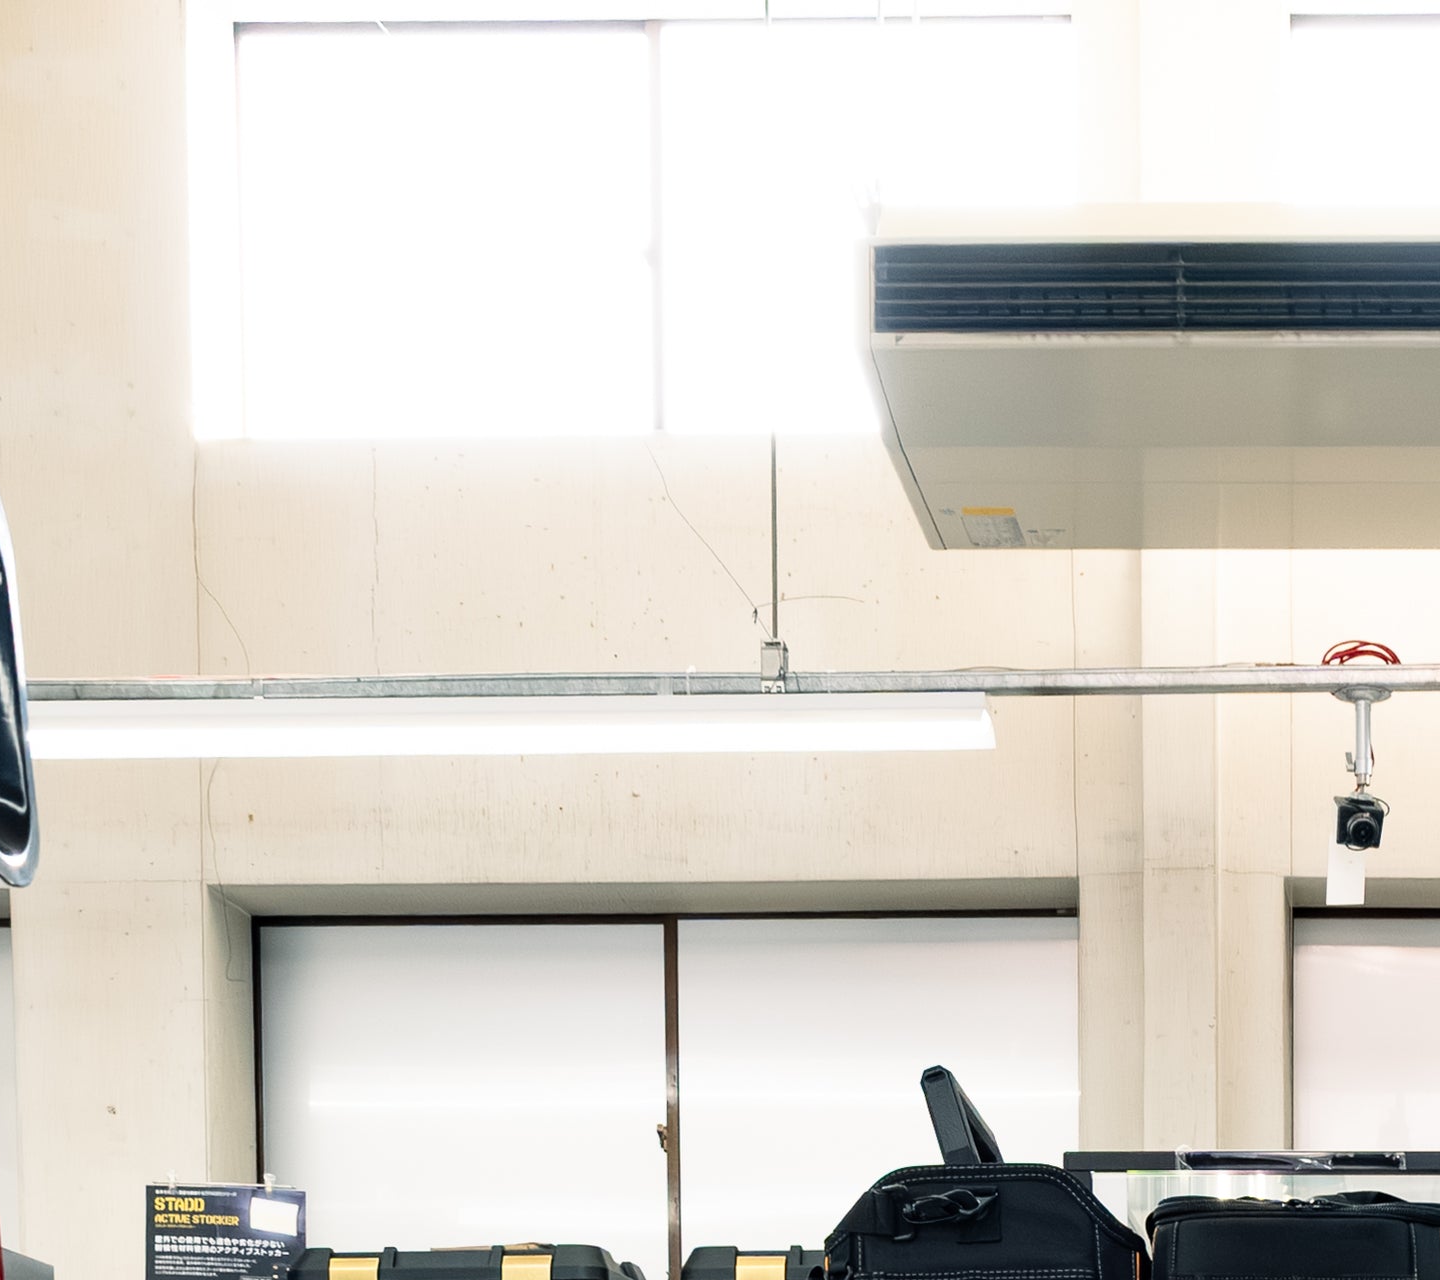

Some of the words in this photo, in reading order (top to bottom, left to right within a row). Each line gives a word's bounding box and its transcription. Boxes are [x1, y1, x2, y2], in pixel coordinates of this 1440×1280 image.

[153, 1196, 206, 1212] STADD
[153, 1213, 191, 1225] ACTIVE
[192, 1214, 241, 1227] STOCKER
